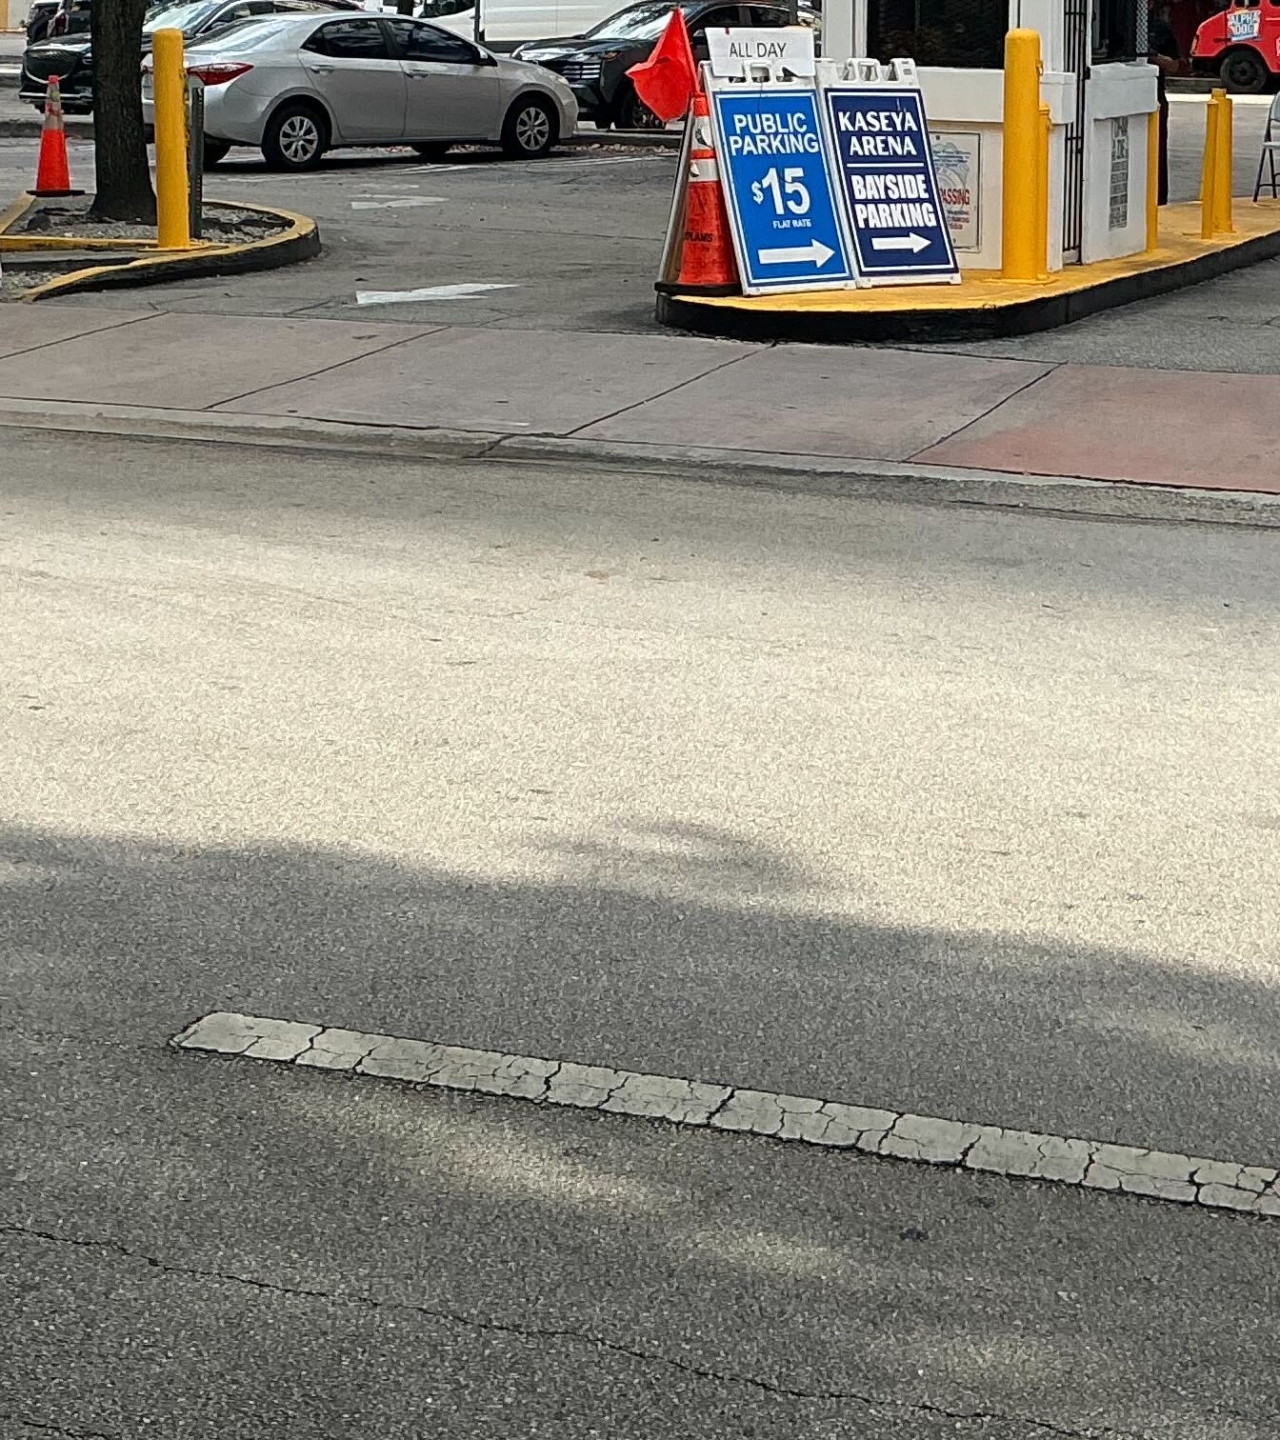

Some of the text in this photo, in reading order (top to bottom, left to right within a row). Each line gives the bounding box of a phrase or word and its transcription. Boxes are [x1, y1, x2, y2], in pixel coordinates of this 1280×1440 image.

[729, 42, 787, 58] ALL DAY
[733, 112, 808, 135] PUBLIC
[838, 111, 919, 132] KASEYA
[728, 132, 820, 157] PARKING
[849, 136, 918, 157] ARENA
[751, 166, 811, 216] $15
[850, 173, 930, 200] BAYSIDE
[939, 188, 970, 205] ASSING
[772, 218, 812, 229] FLAT RATE
[854, 202, 938, 229] PARKING
